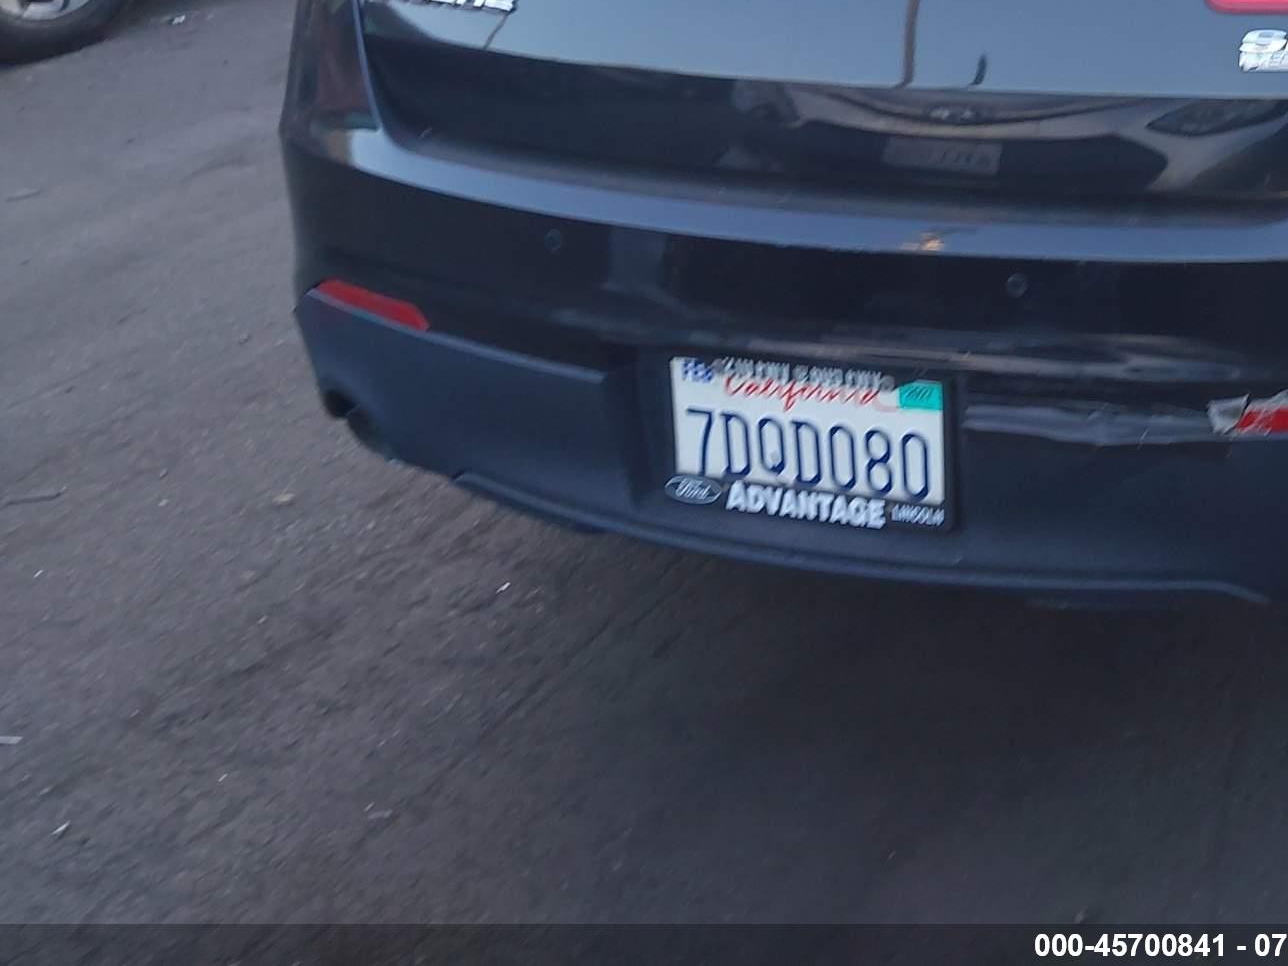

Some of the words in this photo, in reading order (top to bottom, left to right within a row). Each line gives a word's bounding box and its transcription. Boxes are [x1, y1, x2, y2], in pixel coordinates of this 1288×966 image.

[724, 375, 880, 411] California
[685, 408, 930, 500] 7DQD080
[726, 480, 887, 530] ADVANTAGE
